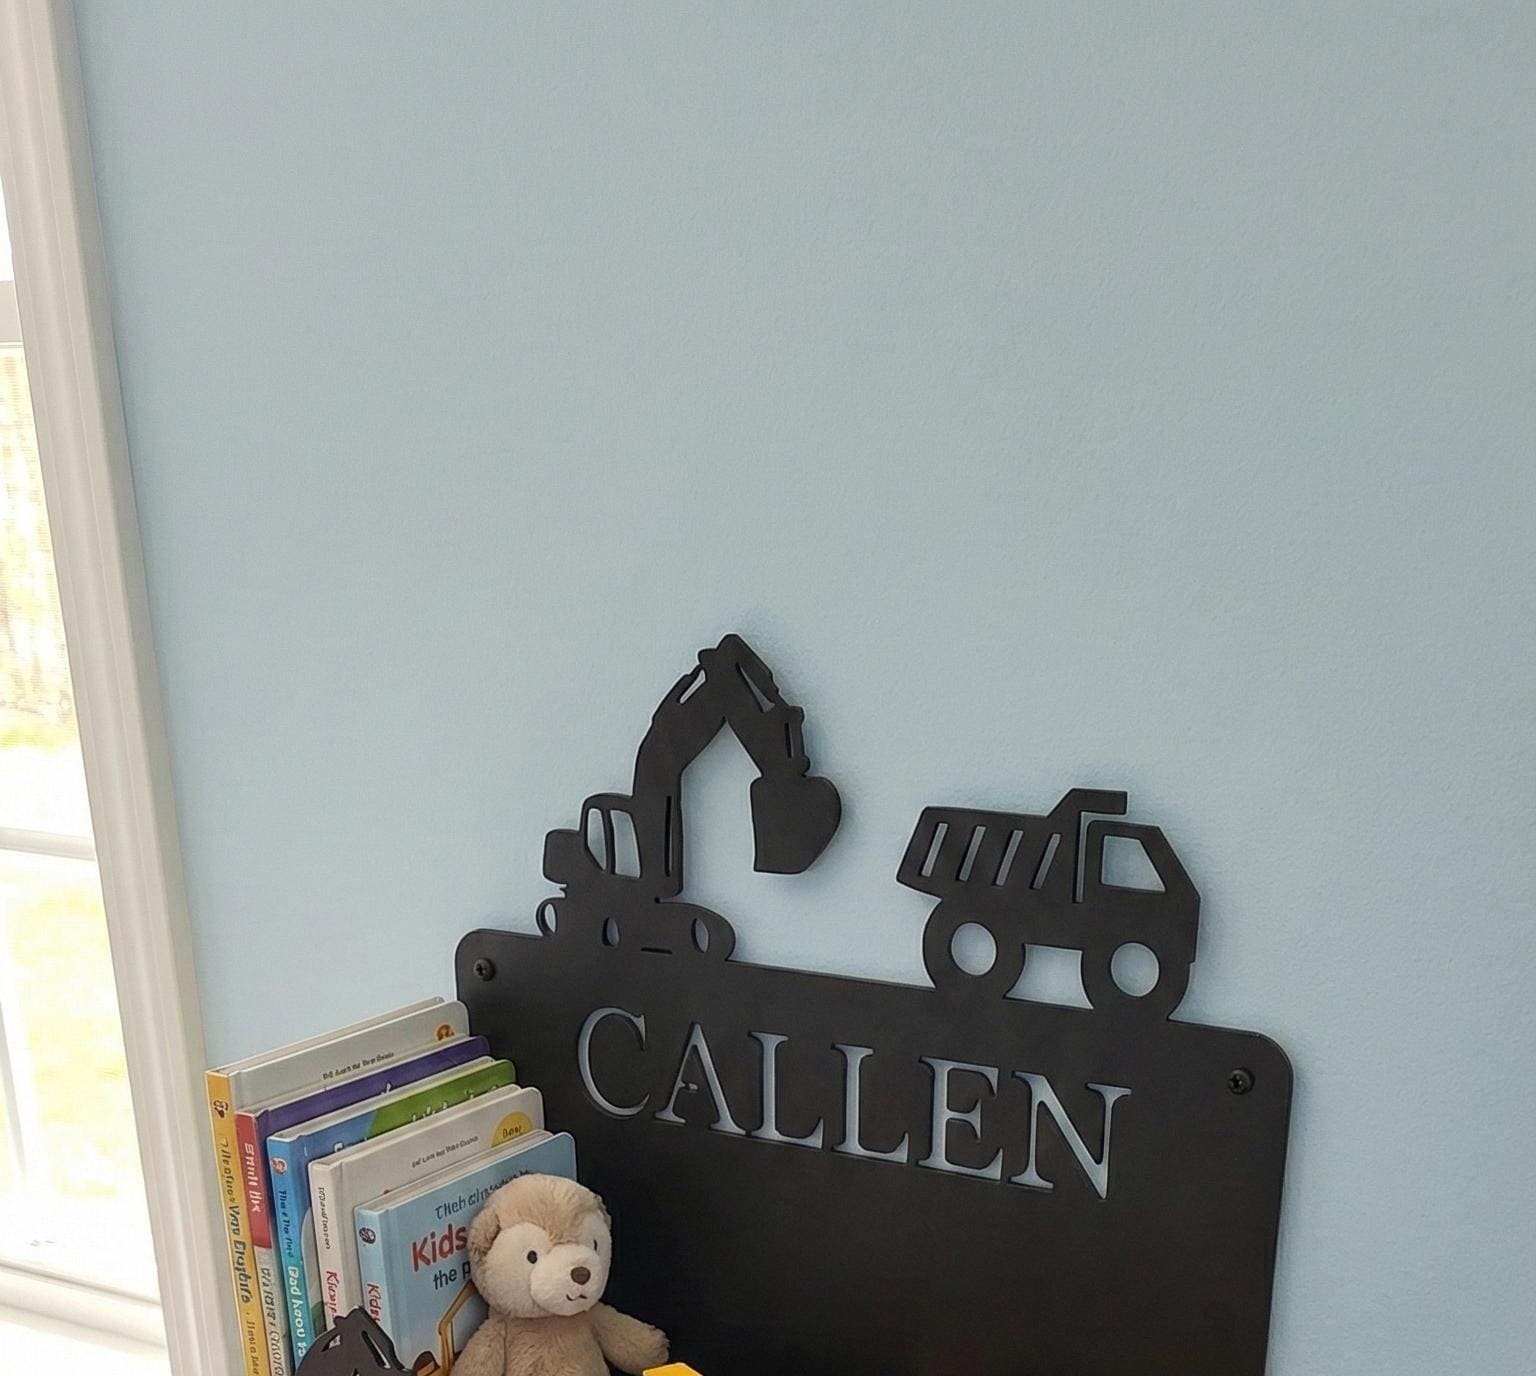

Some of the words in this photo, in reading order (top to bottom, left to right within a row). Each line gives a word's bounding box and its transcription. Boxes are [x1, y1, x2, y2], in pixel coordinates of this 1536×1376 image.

[577, 1006, 1132, 1200] CALLEN
[411, 1223, 468, 1272] Kids
[433, 1268, 458, 1290] the
